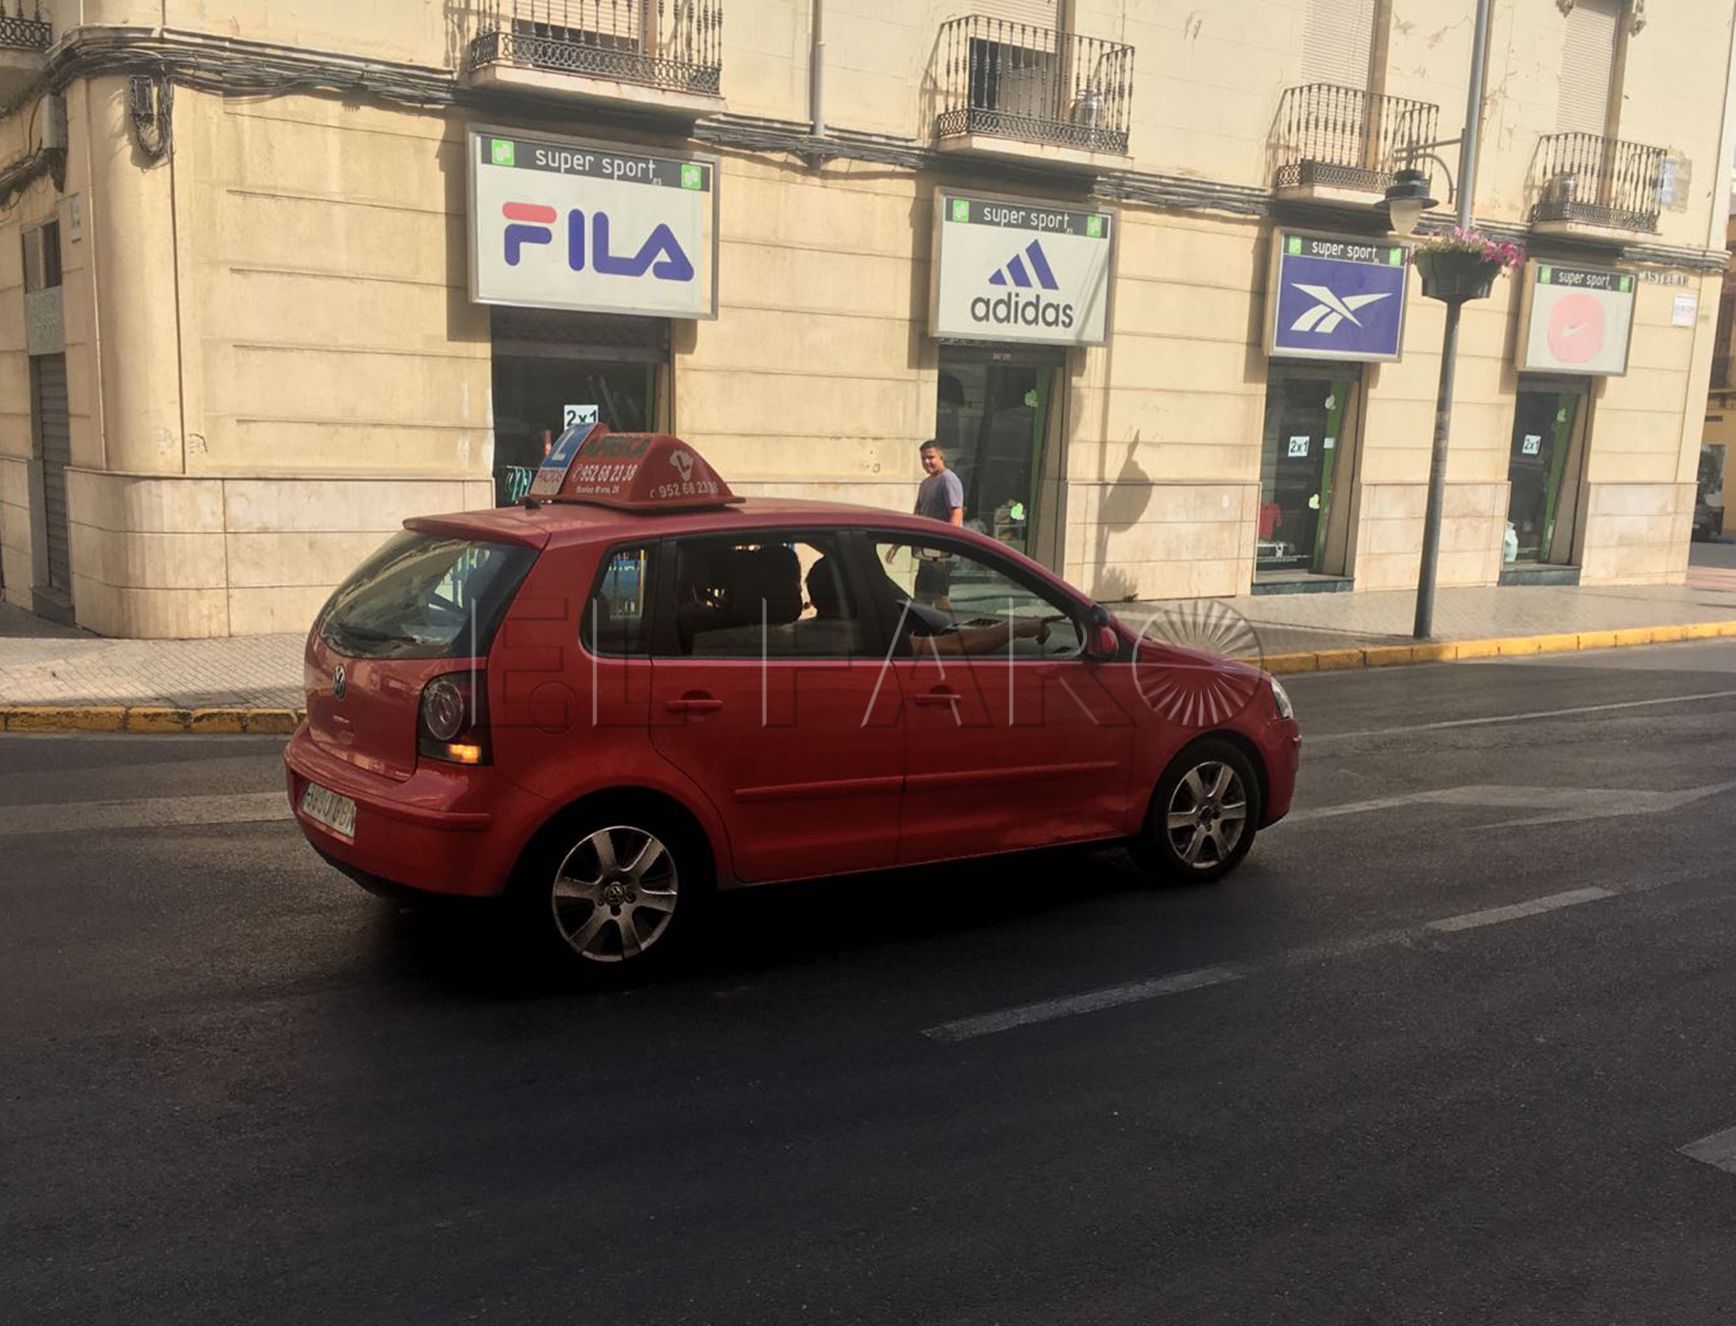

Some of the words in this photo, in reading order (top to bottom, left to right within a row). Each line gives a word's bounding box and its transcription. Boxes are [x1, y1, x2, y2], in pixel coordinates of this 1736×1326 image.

[535, 149, 594, 174] super
[601, 158, 656, 182] sport
[983, 206, 1026, 227] super
[1030, 212, 1070, 233] sport
[502, 201, 694, 282] FILA
[1311, 241, 1344, 260] super
[1346, 244, 1378, 264] sport
[1558, 271, 1584, 287] super
[1586, 274, 1610, 290] sport
[970, 292, 1074, 329] adidas
[1290, 439, 1309, 454] 2x1
[659, 483, 681, 498] 952
